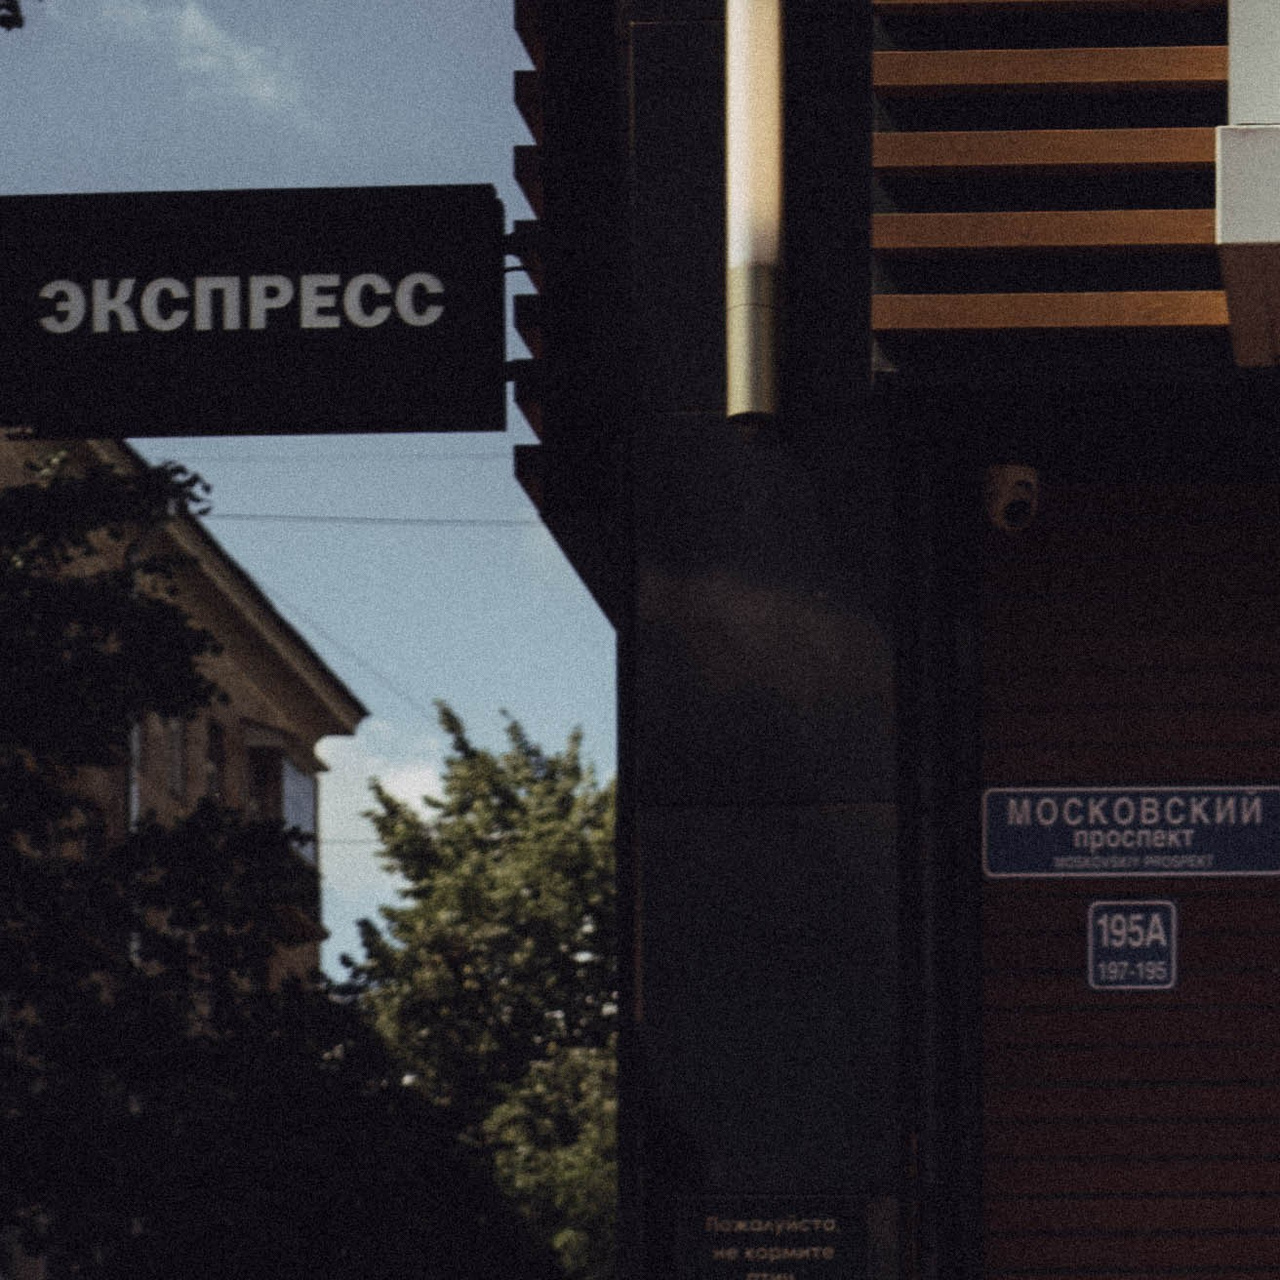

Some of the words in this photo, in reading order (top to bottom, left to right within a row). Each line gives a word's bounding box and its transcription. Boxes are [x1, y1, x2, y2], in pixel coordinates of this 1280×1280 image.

[39, 273, 445, 333] ЭКСПРЕСС
[1007, 792, 1264, 826] МОСКОВСКИЙ
[1073, 828, 1195, 852] проспект
[1098, 912, 1167, 949] 195А
[1098, 961, 1167, 981] 197-195
[712, 1248, 739, 1261] не
[744, 1247, 836, 1263] кормите
